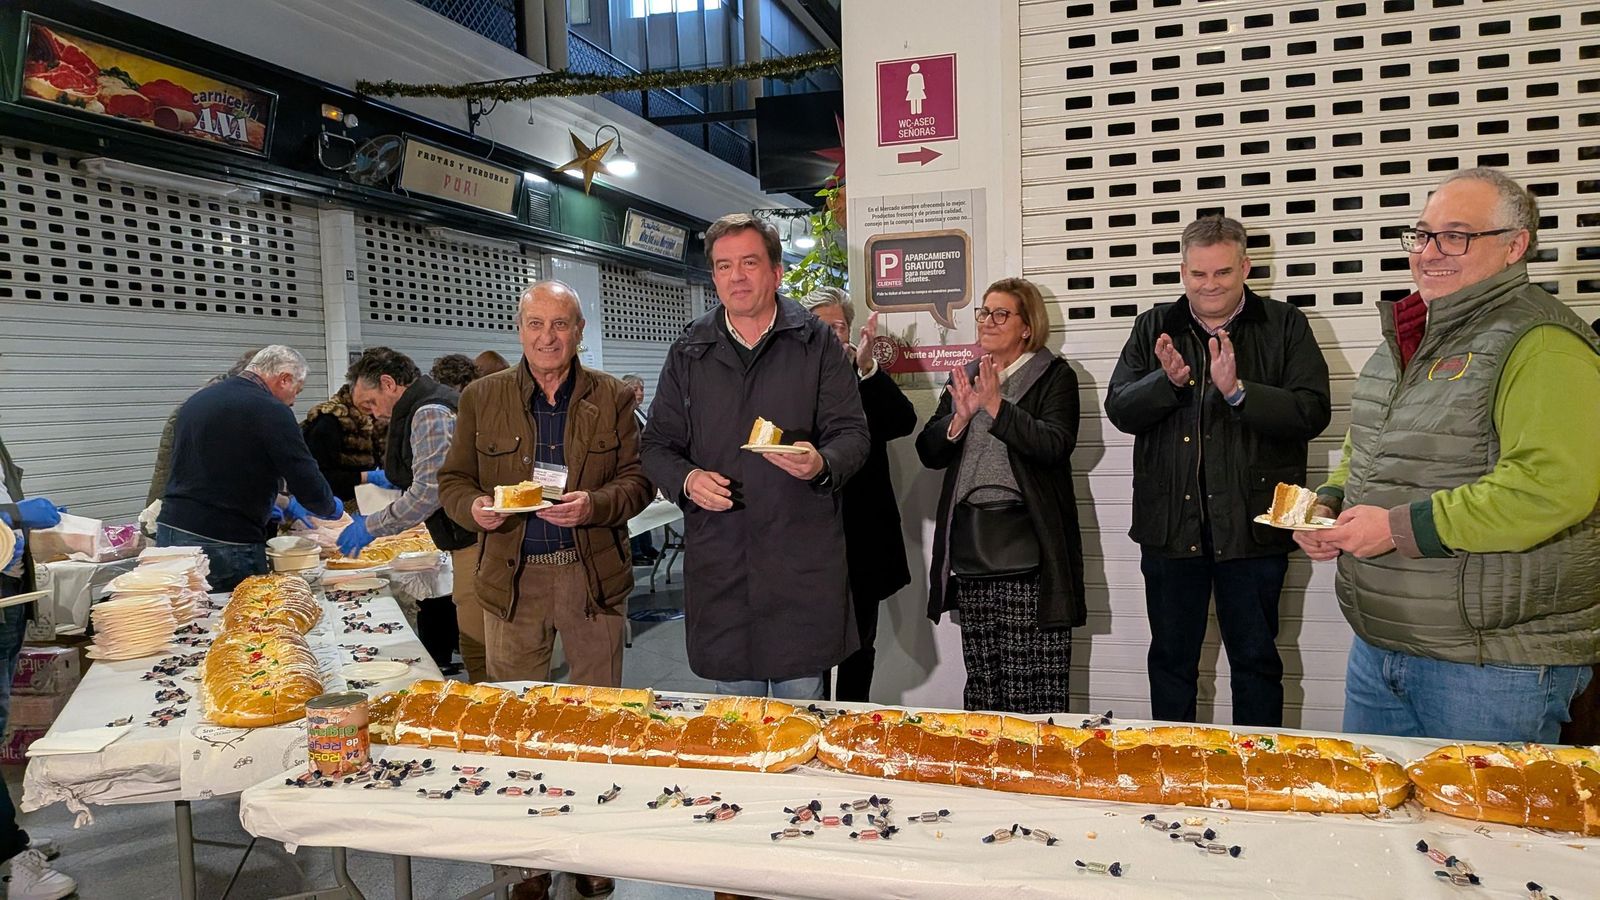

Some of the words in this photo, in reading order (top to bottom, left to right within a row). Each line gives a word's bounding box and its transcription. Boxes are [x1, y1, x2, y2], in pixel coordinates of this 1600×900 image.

[193, 107, 249, 143] ANA
[898, 116, 936, 129] WC-ASEO
[898, 126, 936, 139] SEÑORAS
[416, 149, 455, 168] FRUTAS
[458, 162, 465, 171] Y
[467, 166, 510, 185] VERDURAS
[443, 174, 479, 197] PURI
[871, 212, 896, 220] Productos
[895, 211, 914, 219] frescos
[904, 250, 961, 262] APARCAMIENTO
[880, 253, 899, 278] P
[904, 260, 945, 271] GRATUITO
[904, 270, 919, 279] para
[919, 268, 946, 277] nuestros
[904, 275, 931, 284] clientes.
[903, 350, 927, 360] Vente
[927, 349, 936, 359] al
[937, 348, 974, 359] Mercado,
[346, 737, 359, 747] de
